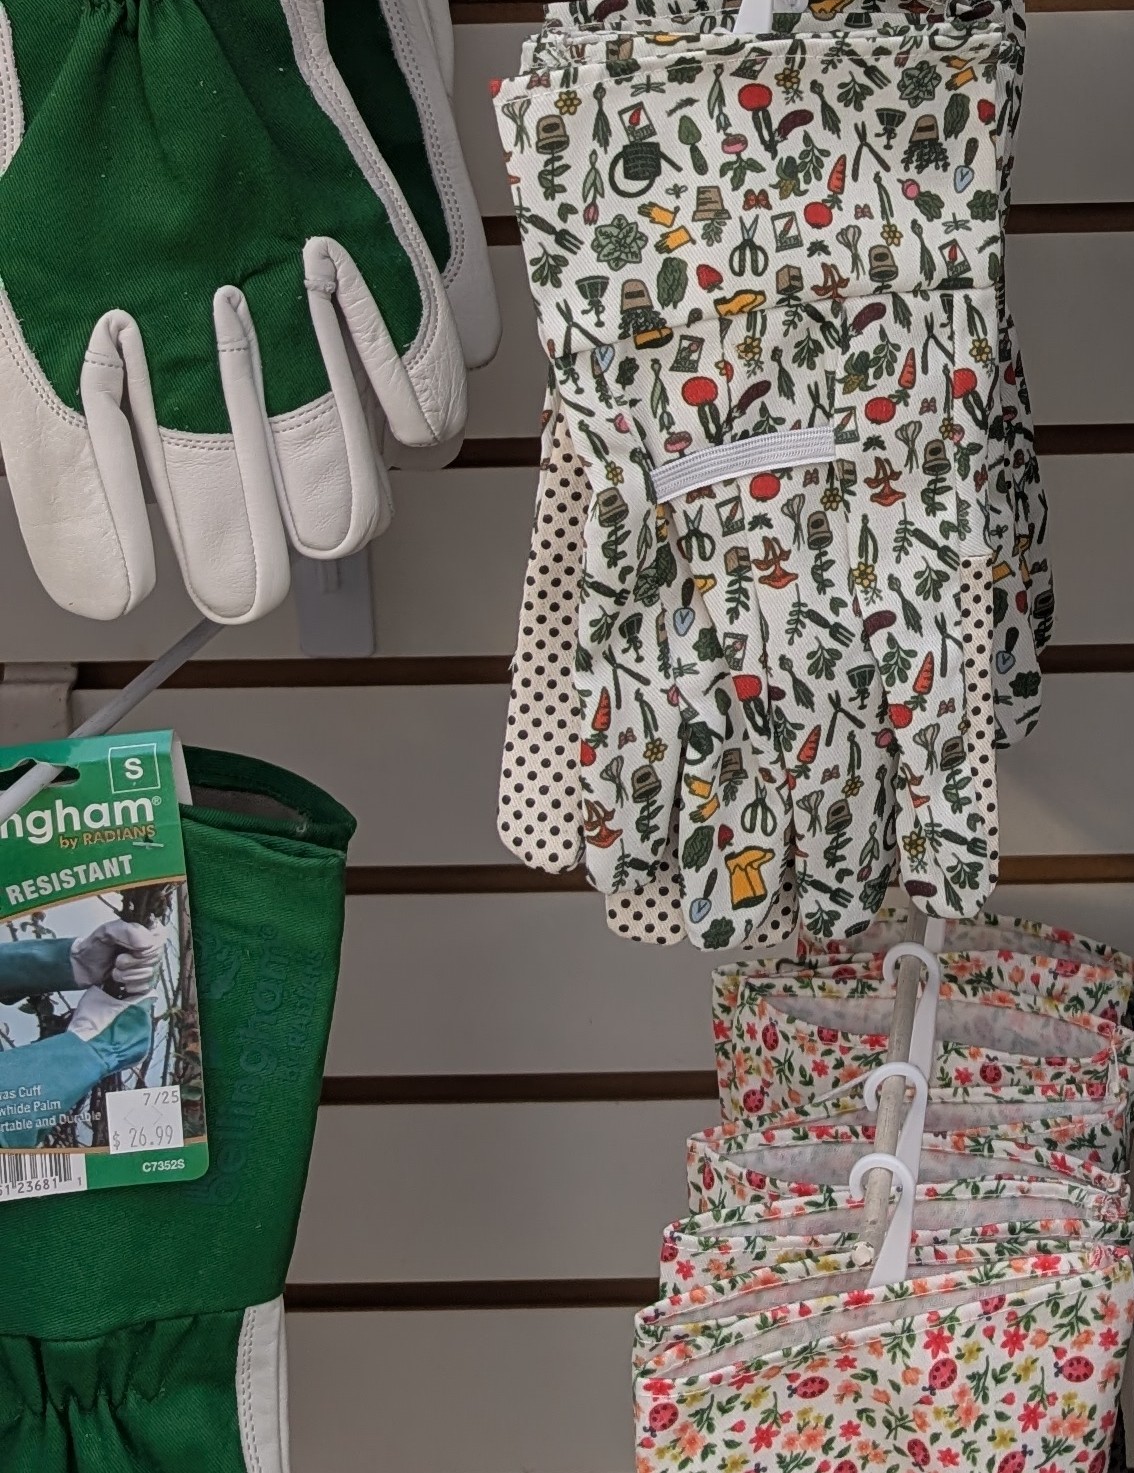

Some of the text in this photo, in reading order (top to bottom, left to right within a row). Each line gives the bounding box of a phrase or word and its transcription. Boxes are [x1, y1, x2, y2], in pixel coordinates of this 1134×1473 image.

[123, 757, 144, 780] S
[59, 824, 156, 850] by RADIANS
[5, 854, 133, 906] RESISTANT
[18, 1084, 42, 1098] Cuff
[142, 1089, 180, 1106] 7/25
[33, 1099, 62, 1112] Palm
[35, 1114, 57, 1128] and
[59, 1110, 102, 1125] Durable
[112, 1124, 174, 1150] $ 26.99
[142, 1158, 186, 1173] C7352S
[17, 1177, 58, 1194] 23681
